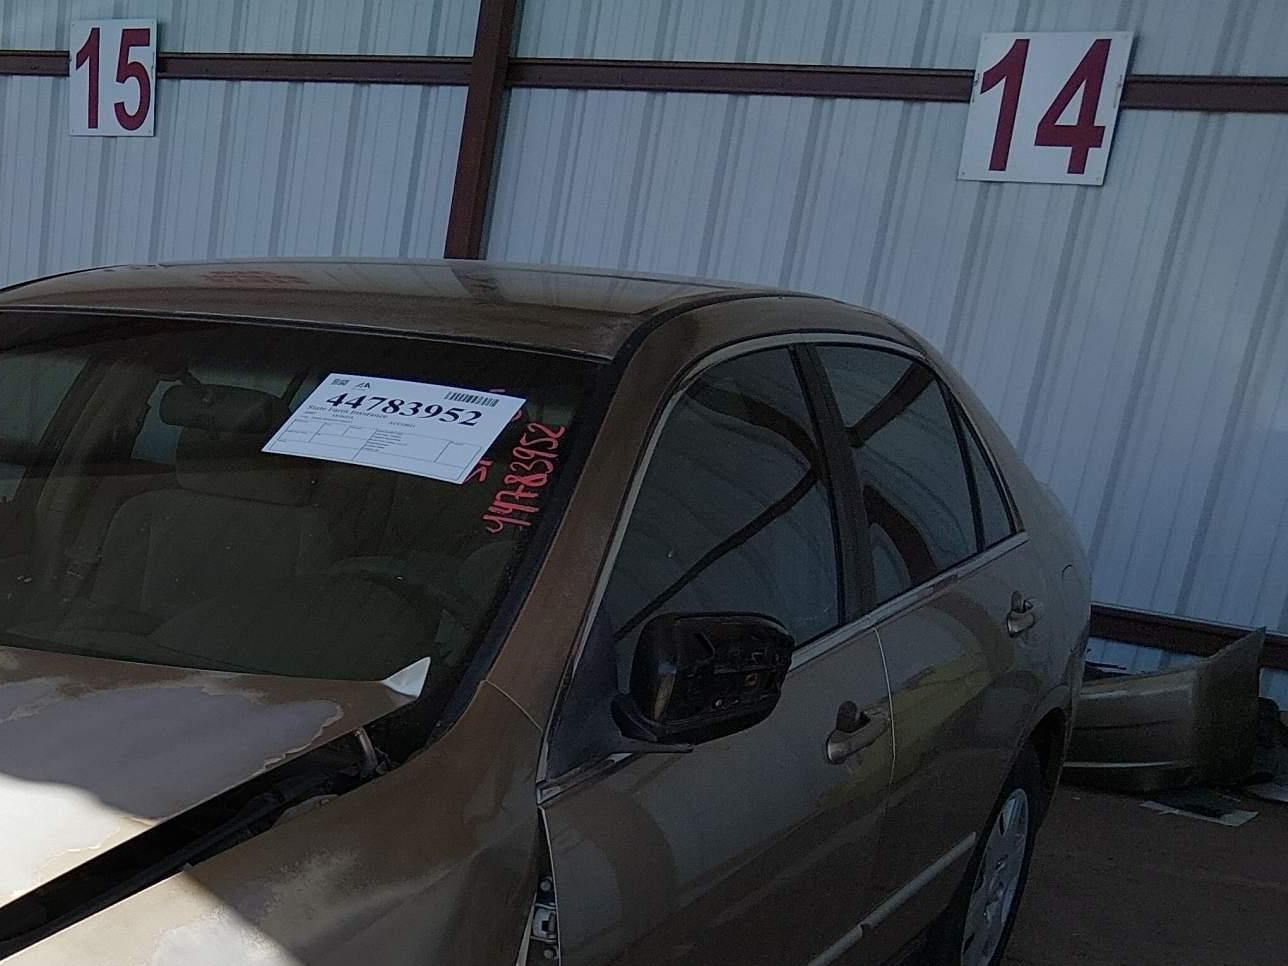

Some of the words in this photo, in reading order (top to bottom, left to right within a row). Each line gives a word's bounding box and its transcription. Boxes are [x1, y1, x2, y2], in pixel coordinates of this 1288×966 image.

[75, 27, 151, 131] 15
[980, 38, 1112, 175] 14
[325, 392, 483, 427] 44783952
[483, 422, 566, 534] 44783952
